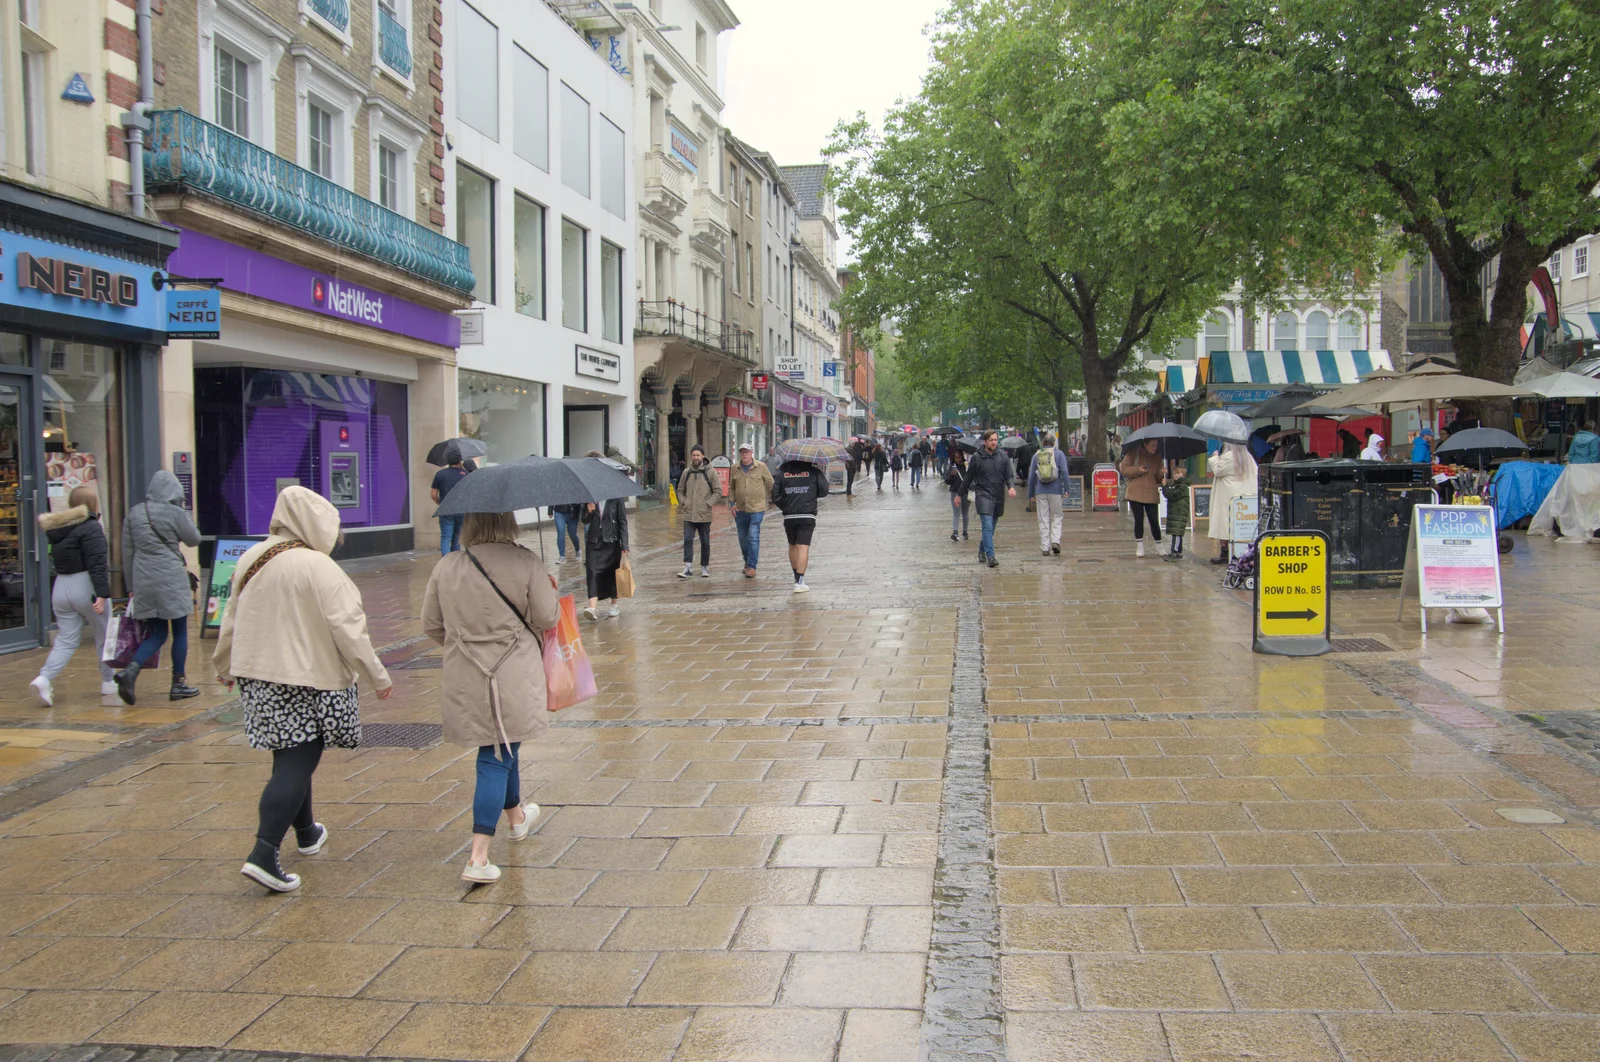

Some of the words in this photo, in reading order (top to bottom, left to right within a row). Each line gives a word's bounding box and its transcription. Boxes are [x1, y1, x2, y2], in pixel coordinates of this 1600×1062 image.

[18, 252, 138, 308] NERO
[328, 281, 383, 324] NatWest
[168, 311, 217, 323] NERO
[784, 486, 809, 494] SPIRIT
[1236, 502, 1248, 511] The
[1440, 511, 1467, 522] PDP
[1425, 522, 1486, 534] FASHION
[1265, 546, 1321, 557] BARBER'S
[1278, 563, 1308, 574] SHOP
[1264, 586, 1284, 595] ROW
[1286, 586, 1293, 595] D
[1294, 586, 1309, 595] No.
[1310, 585, 1322, 595] 85
[554, 638, 583, 661] NEXT
